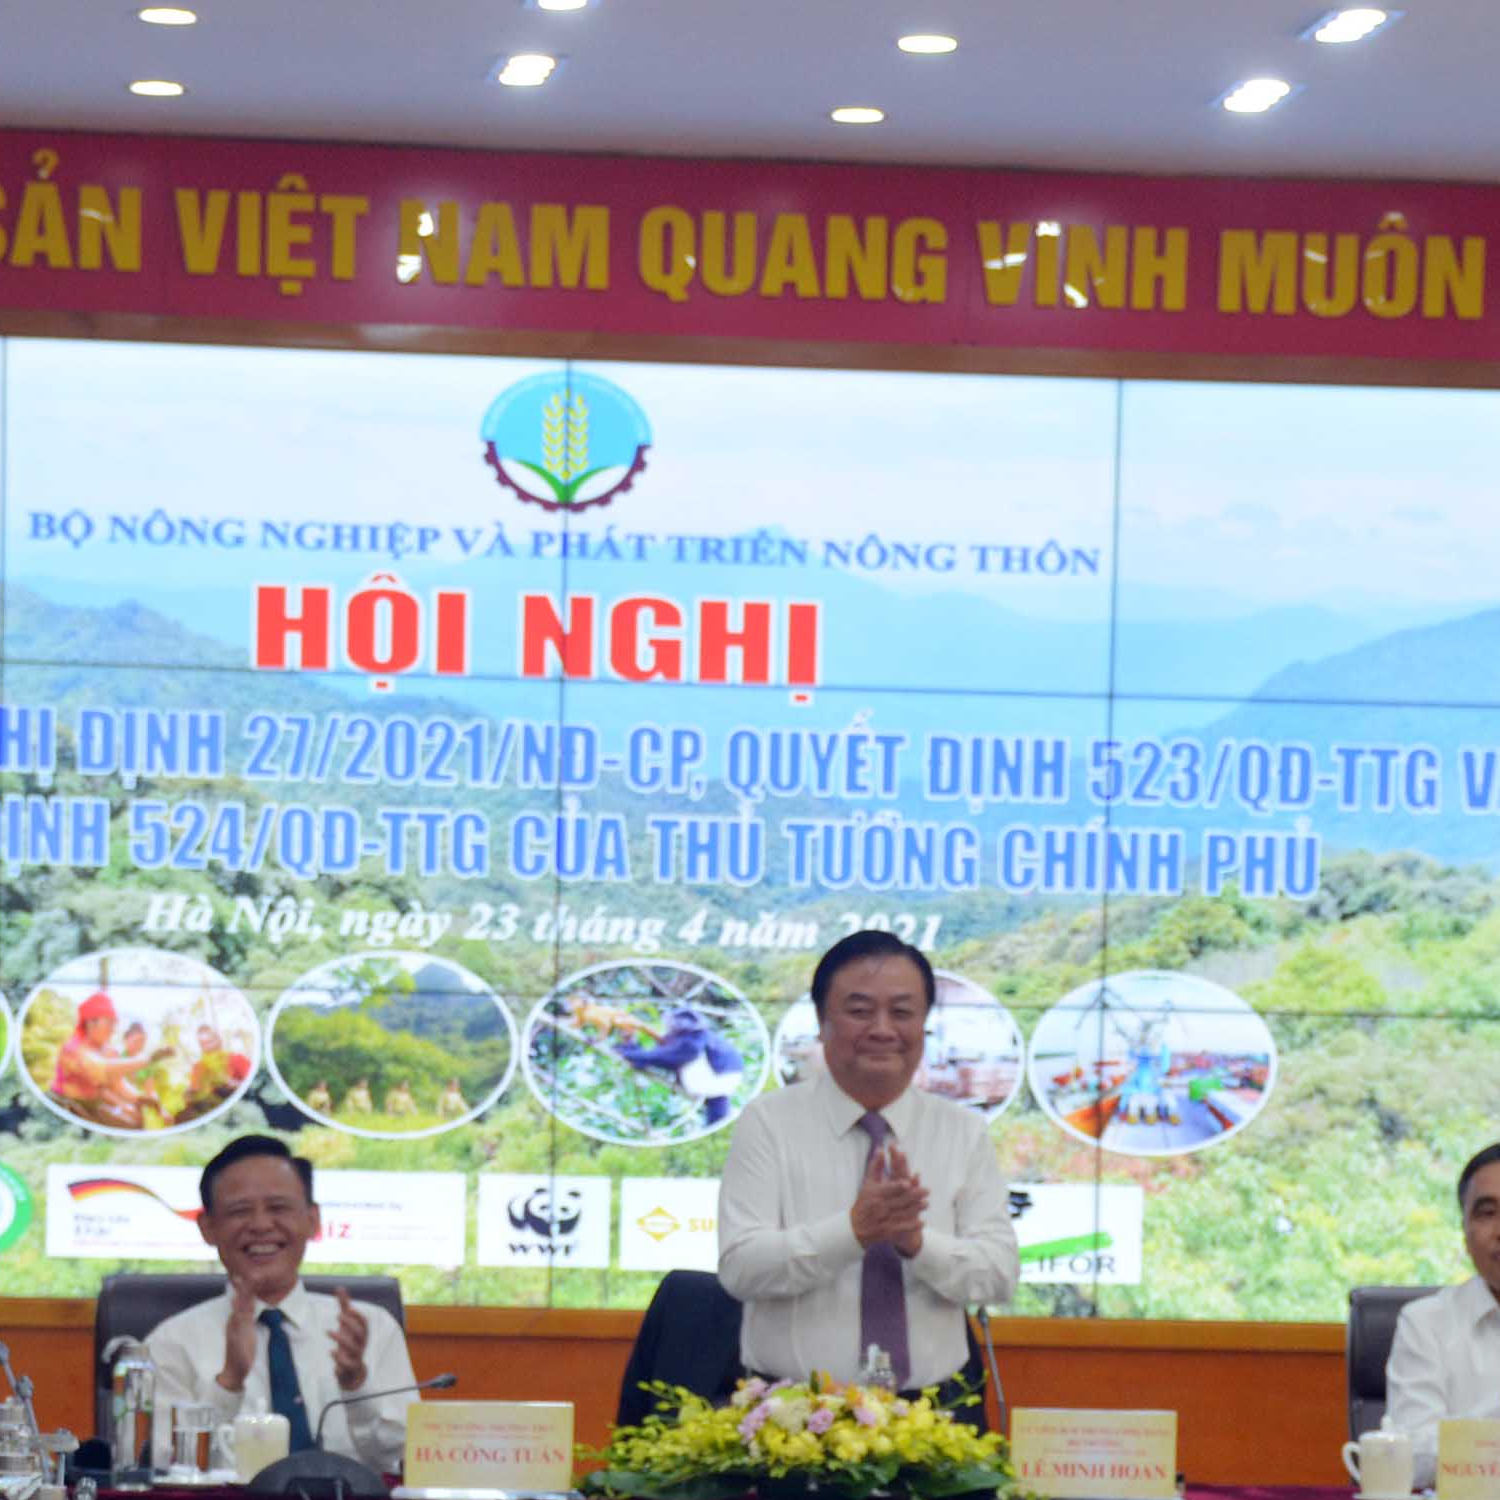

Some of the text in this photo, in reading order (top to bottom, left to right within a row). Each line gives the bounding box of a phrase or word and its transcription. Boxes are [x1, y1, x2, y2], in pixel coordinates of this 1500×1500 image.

[173, 172, 369, 295] VIỆT
[396, 196, 609, 291] NAM
[638, 203, 948, 305] QUANG
[977, 217, 1187, 312] VINH
[1217, 211, 1486, 321] MUÔN
[28, 507, 1101, 577] BỘ NÔNG NGHIỆP VÀ PHÁT TRIỂN NÔNG THÔN
[256, 573, 820, 703] HỘI NGHỊ
[79, 710, 221, 790] ĐỊNH
[245, 715, 705, 800] 27/2021/NĐ-CP,
[728, 708, 905, 796] QUYẾT
[929, 736, 1068, 814] ĐỊNH
[1091, 740, 1439, 814] 523/QĐ-TTG
[131, 803, 488, 881] 524/QĐ-TTG
[513, 797, 626, 880] CỦA
[651, 802, 764, 885] THỦ
[1003, 816, 1182, 894] CHÍNH
[1206, 818, 1319, 896] PHỦ
[142, 894, 214, 934] Hà
[228, 895, 323, 945] Nội,
[338, 902, 452, 948] ngày
[463, 904, 518, 940] 23
[531, 905, 665, 953] tháng
[677, 908, 709, 946] 4
[718, 911, 818, 948] năm
[1019, 1255, 1116, 1276] IFOR
